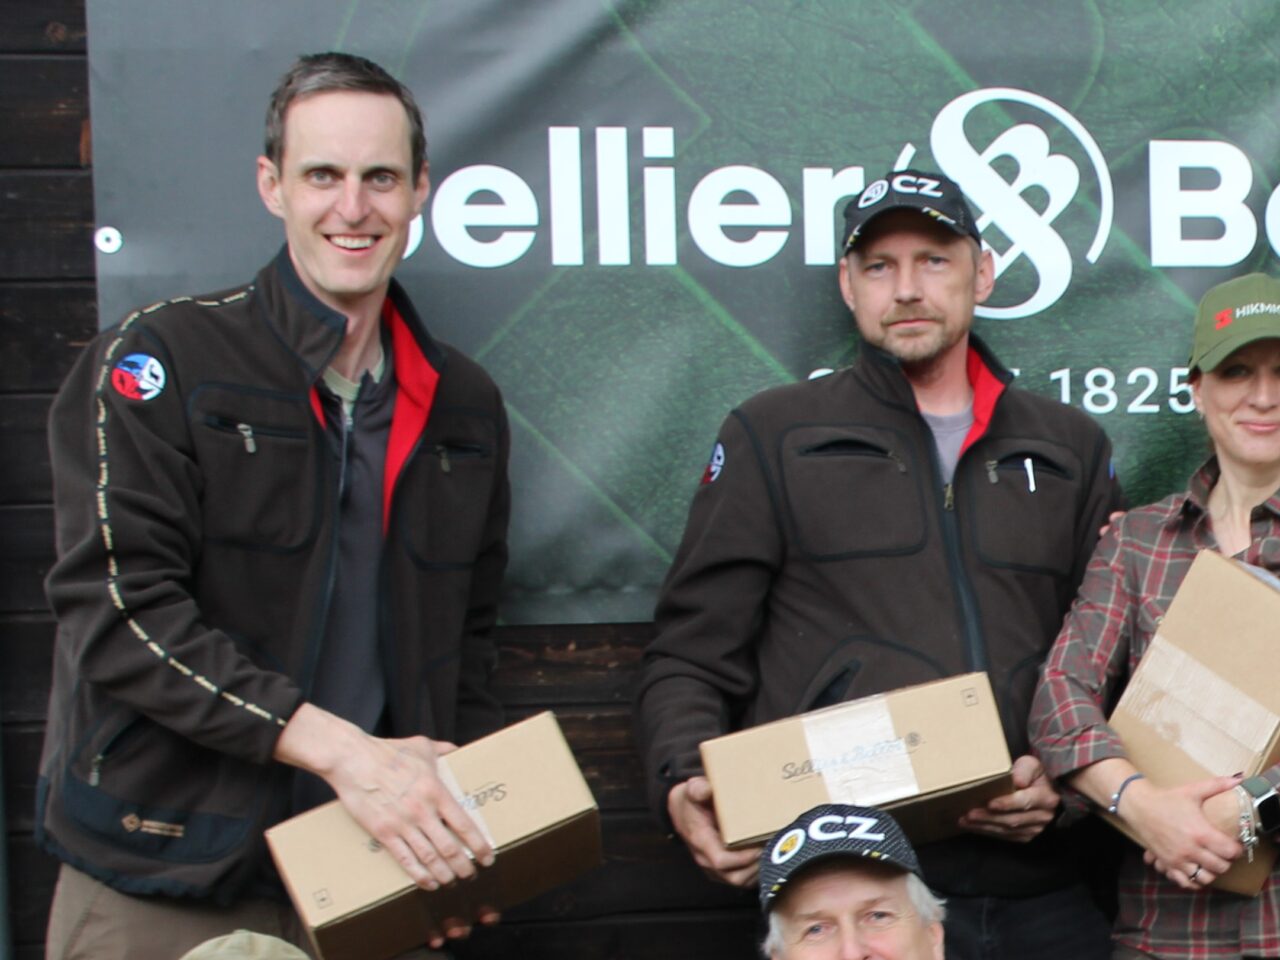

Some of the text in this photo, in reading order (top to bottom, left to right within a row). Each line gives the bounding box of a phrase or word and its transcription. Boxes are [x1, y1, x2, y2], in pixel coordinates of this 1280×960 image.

[402, 126, 866, 269] ellier
[892, 175, 944, 198] CZ
[1050, 367, 1198, 414] 1825
[808, 815, 885, 842] CZ
